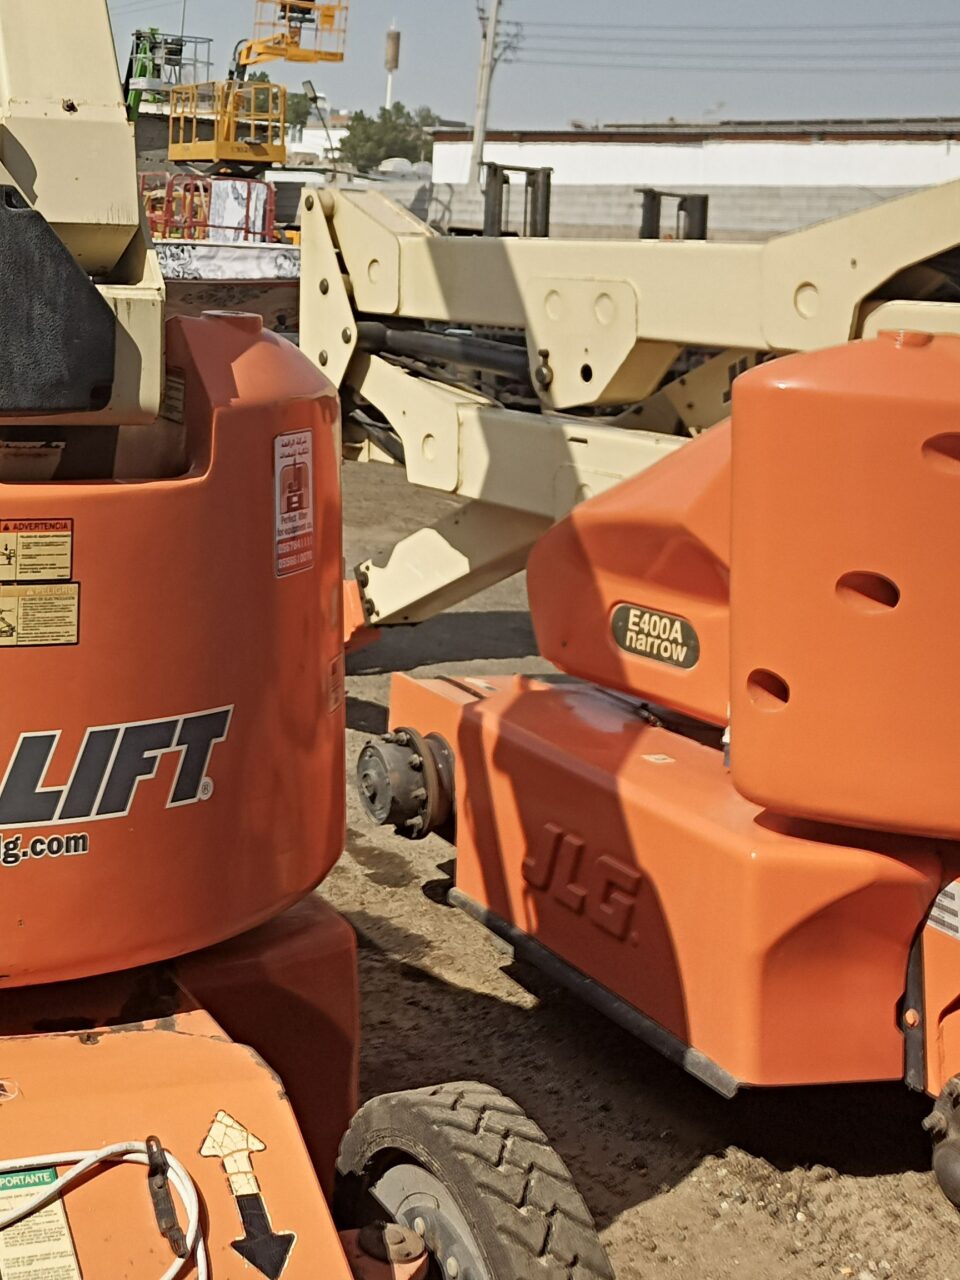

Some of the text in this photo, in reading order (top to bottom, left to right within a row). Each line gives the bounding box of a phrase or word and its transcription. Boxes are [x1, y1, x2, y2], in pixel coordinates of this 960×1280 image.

[13, 521, 69, 531] ADVERTENCIA
[35, 586, 74, 596] PELIGRO
[626, 608, 682, 643] E400A
[624, 631, 687, 663] narrow
[521, 820, 644, 944] JLG
